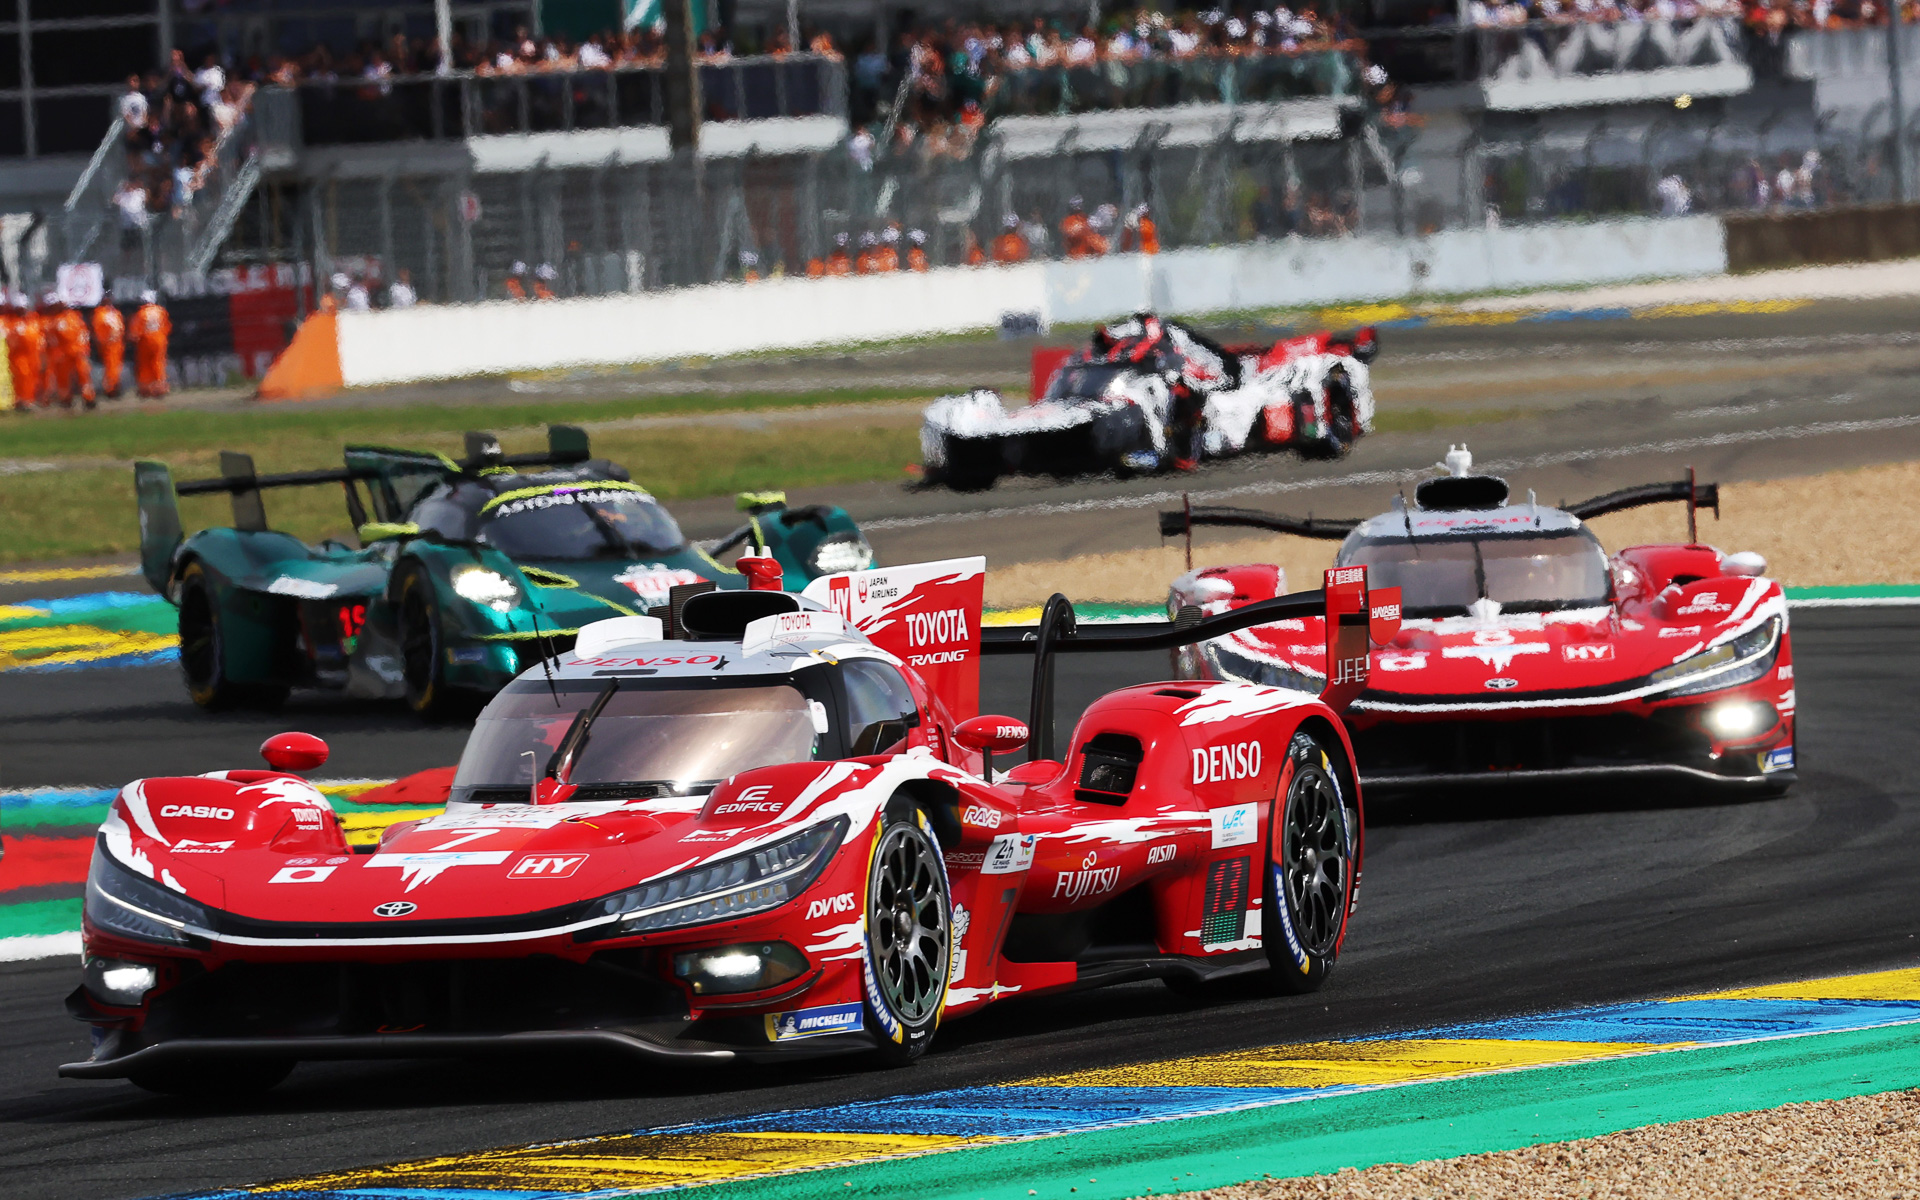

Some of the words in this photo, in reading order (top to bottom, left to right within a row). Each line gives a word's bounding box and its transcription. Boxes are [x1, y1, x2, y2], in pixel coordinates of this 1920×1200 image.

[869, 577, 888, 587] JAPAN
[871, 587, 898, 600] AIRLINES
[1371, 604, 1400, 620] HAYASHI
[781, 614, 811, 632] TOYOTA
[904, 607, 969, 647] TOYOTA
[567, 654, 719, 667] DENSO
[907, 649, 970, 667] RACING
[1333, 656, 1365, 685] JFE
[996, 725, 1029, 739] DENSO
[1192, 740, 1262, 785] DENSO
[160, 804, 235, 821] CASIO
[291, 807, 320, 822] TOYOTA
[714, 801, 783, 815] EDIFICE
[963, 805, 1001, 829] RAYS
[427, 828, 501, 852] 7
[1147, 844, 1178, 865] AISIN
[514, 857, 583, 875] HY
[1051, 865, 1122, 905] FUJITSU
[800, 1012, 857, 1030] MICHELIN
